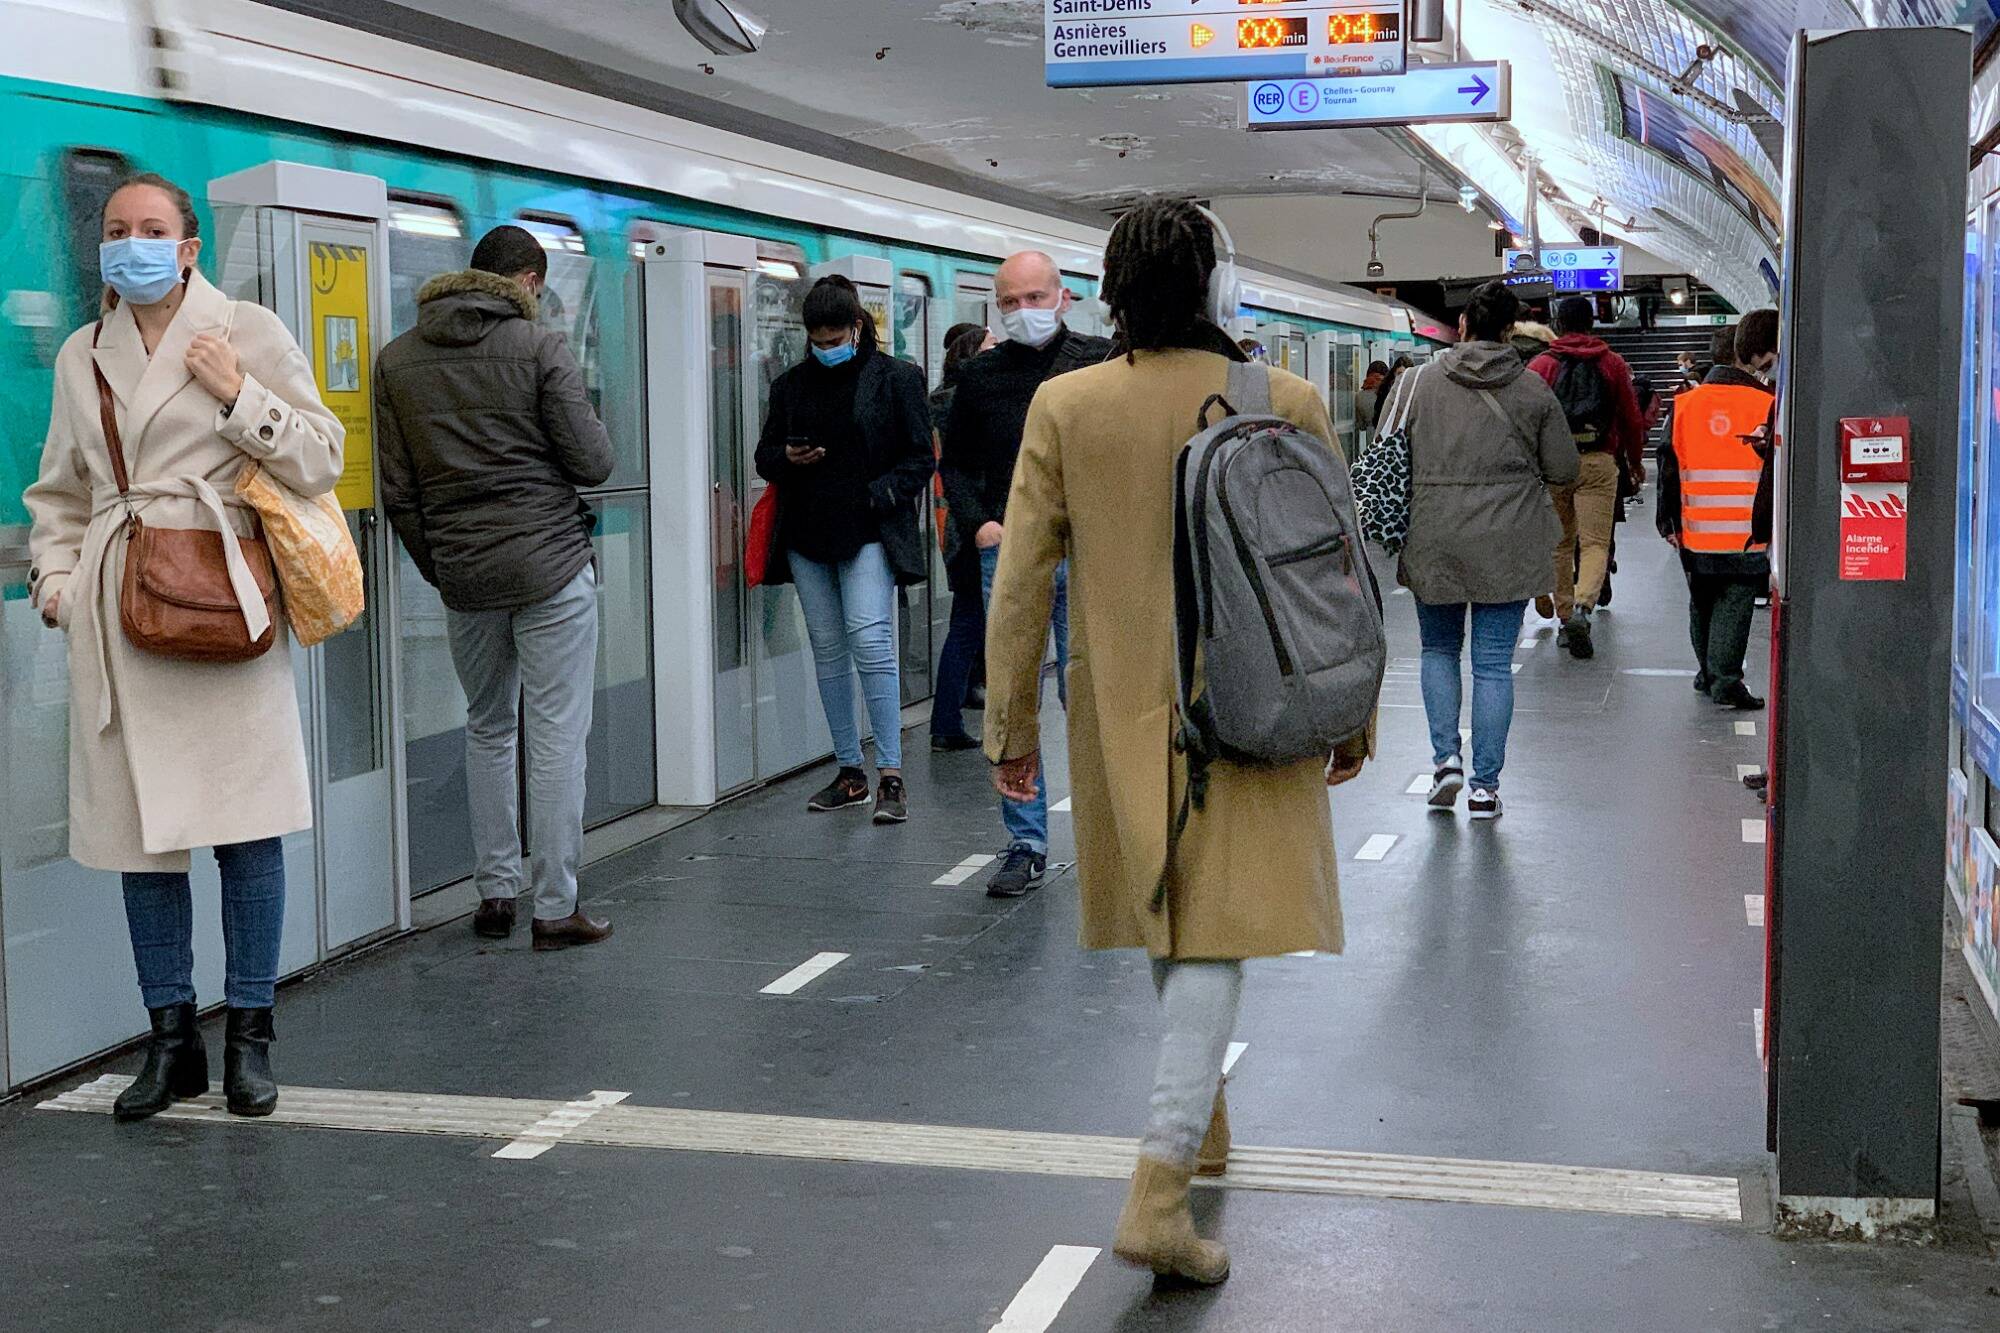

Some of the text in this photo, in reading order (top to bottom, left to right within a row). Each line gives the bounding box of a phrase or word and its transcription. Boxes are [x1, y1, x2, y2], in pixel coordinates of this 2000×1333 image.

[1053, 0, 1152, 14] Saint-Denis
[1053, 23, 1127, 41] Asnières
[1239, 17, 1306, 48] 00 min
[1330, 12, 1398, 44] 04 min
[1053, 39, 1167, 58] Gennevilliers
[1323, 87, 1353, 96] Chelles
[1360, 85, 1396, 96] Gournay
[1257, 93, 1281, 105] RER
[1298, 90, 1309, 106] E
[1323, 97, 1358, 105] Tournan
[1551, 255, 1559, 264] M
[1564, 255, 1575, 265] 12
[1845, 534, 1883, 543] Alarme
[1845, 543, 1890, 553] Incendie
